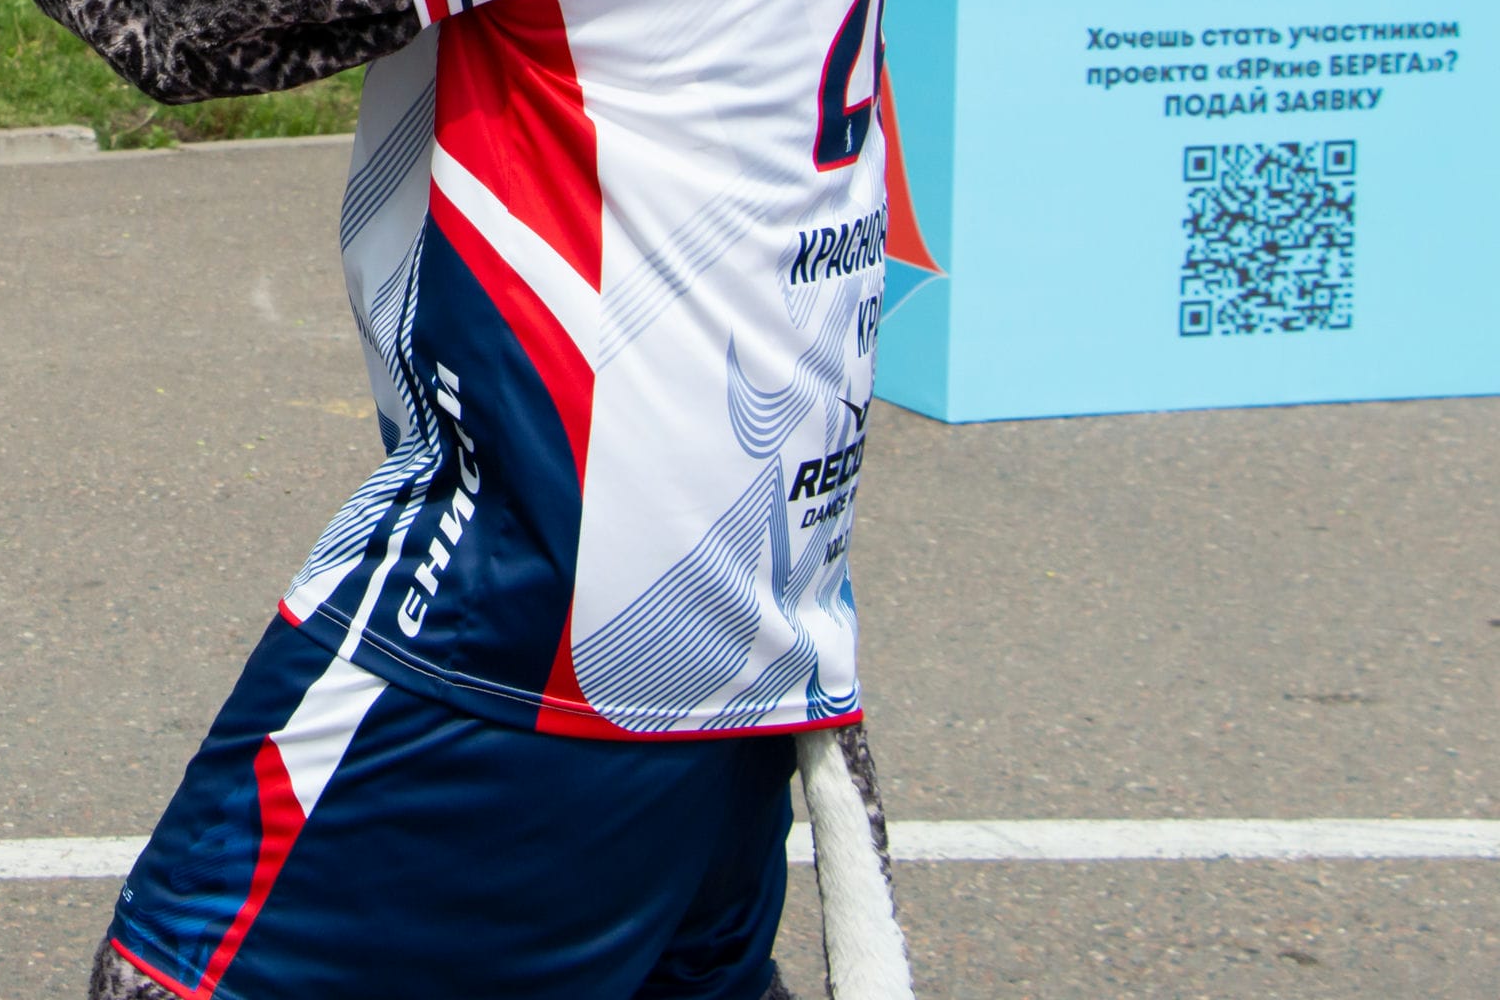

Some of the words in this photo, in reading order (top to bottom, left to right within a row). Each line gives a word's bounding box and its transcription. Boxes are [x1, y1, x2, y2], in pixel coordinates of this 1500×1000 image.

[1087, 27, 1195, 51] Хочешь
[1201, 26, 1281, 47] стать
[1288, 20, 1460, 49] участником
[1087, 63, 1208, 90] проекта
[1329, 50, 1460, 77] БЕРЕГА»?
[1164, 86, 1268, 118] ПОДАЙ
[1276, 86, 1384, 114] ЗАЯВКУ
